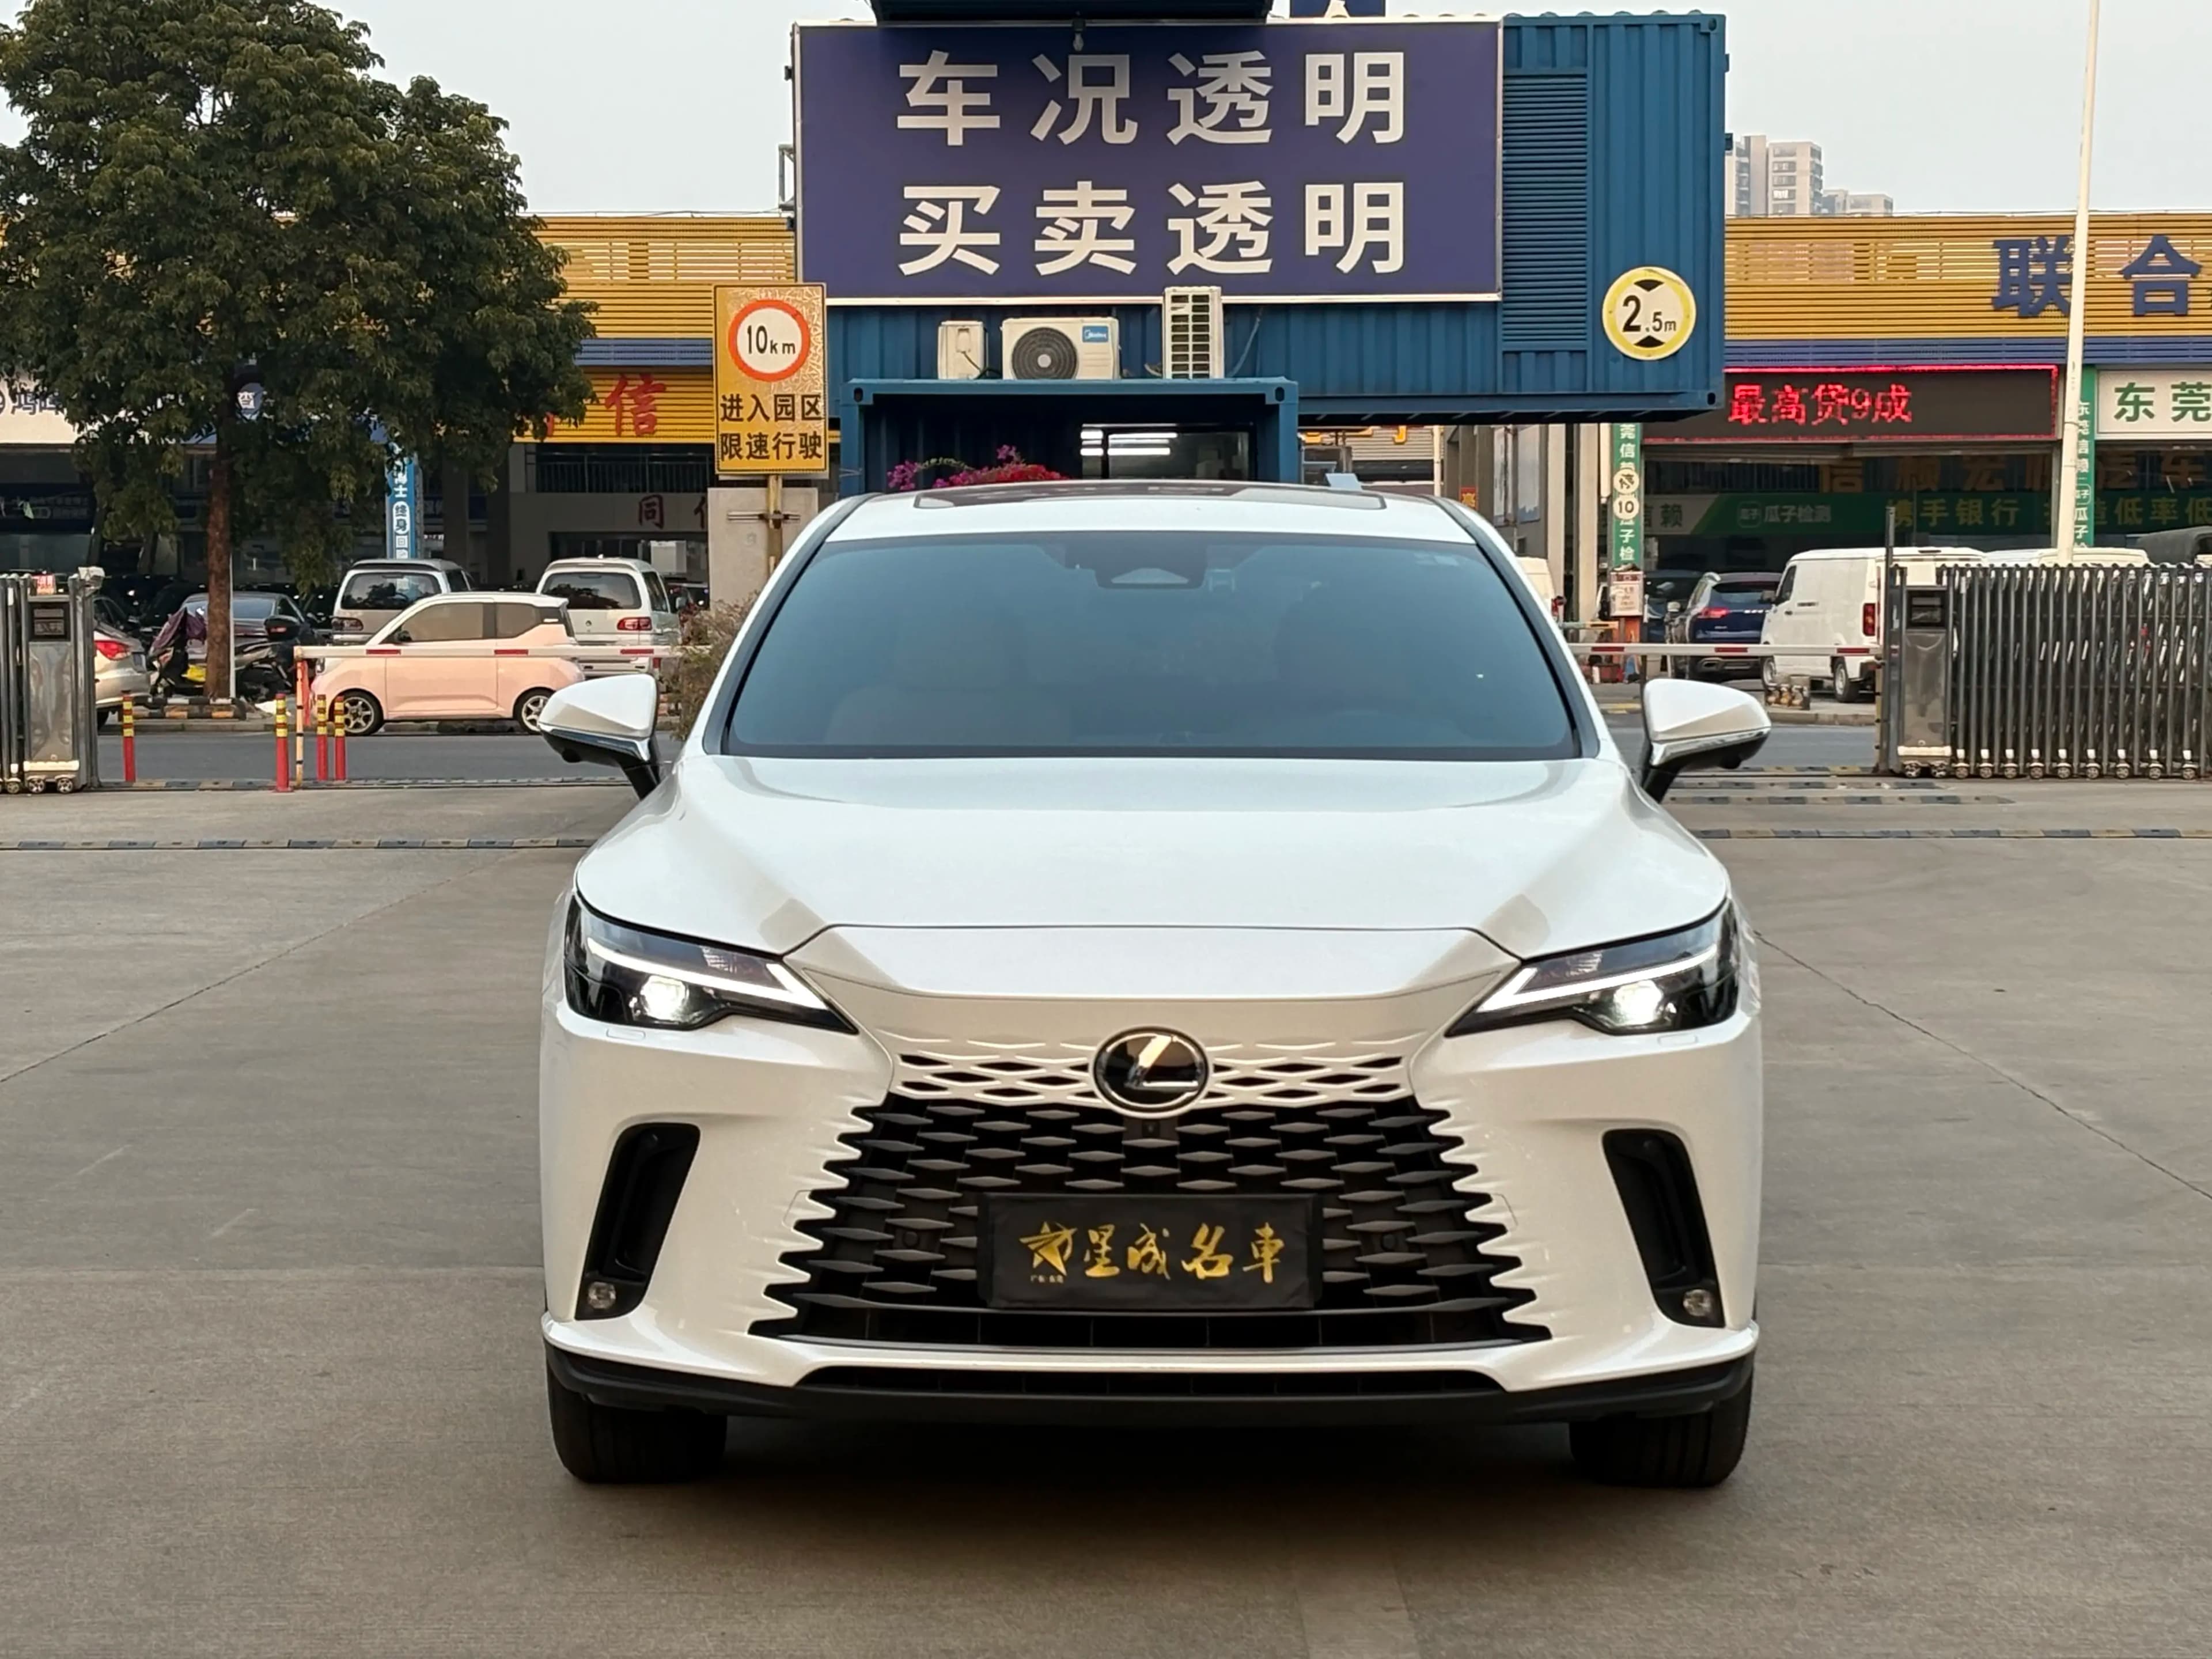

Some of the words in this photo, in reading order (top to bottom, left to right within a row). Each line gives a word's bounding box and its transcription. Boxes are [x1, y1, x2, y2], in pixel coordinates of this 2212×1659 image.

[897, 49, 1404, 146] 车况透明
[897, 180, 1404, 275] 买卖透明
[1622, 294, 1677, 333] 2.5m
[747, 324, 796, 355] 10km
[720, 393, 824, 422] 进入园区
[1729, 382, 1912, 426] 最高贷9成
[2113, 381, 2212, 423] 东莞
[719, 431, 823, 461] 限速行驶
[1618, 500, 1635, 513] 10
